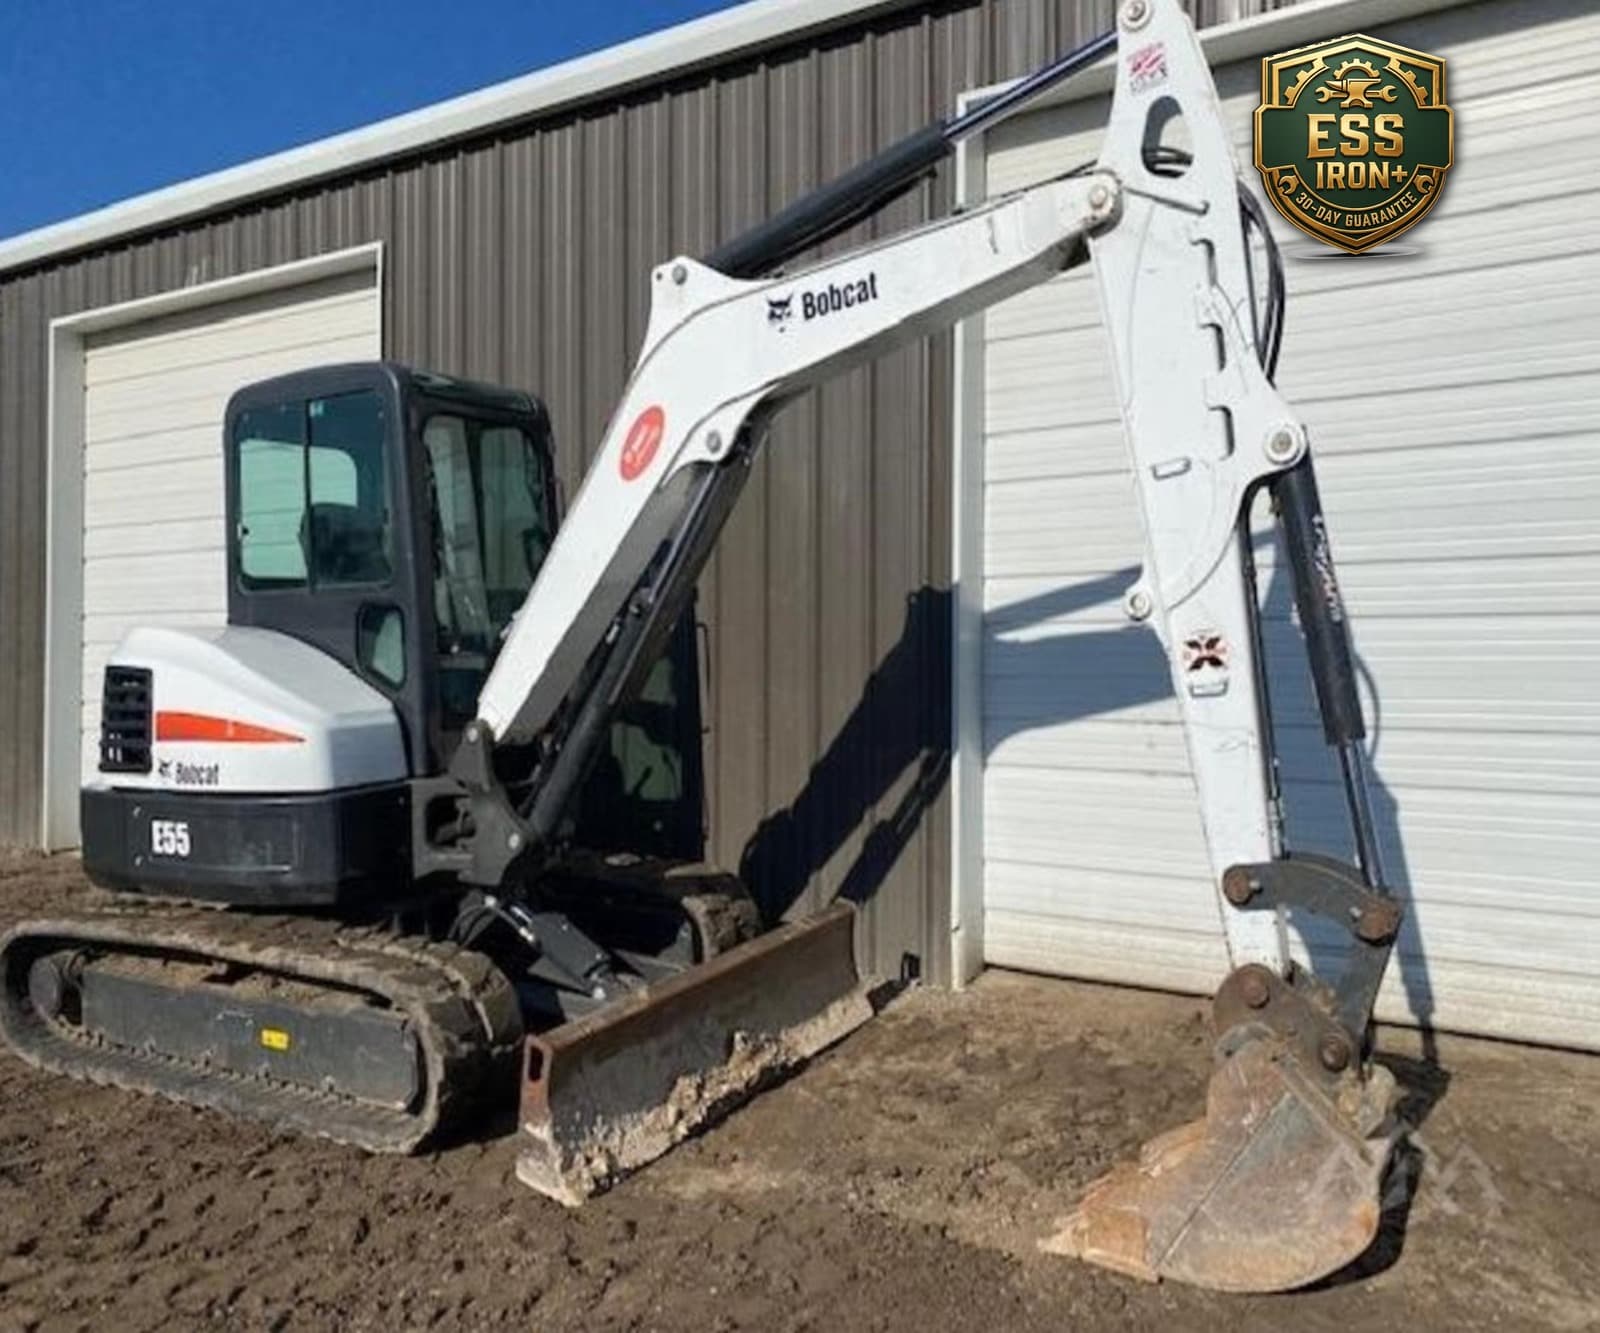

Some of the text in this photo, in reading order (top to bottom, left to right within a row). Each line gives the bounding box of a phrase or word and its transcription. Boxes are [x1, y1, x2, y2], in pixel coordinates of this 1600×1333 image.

[801, 271, 878, 320] Bobcat
[175, 762, 219, 785] Bobcat
[151, 820, 191, 856] E55
